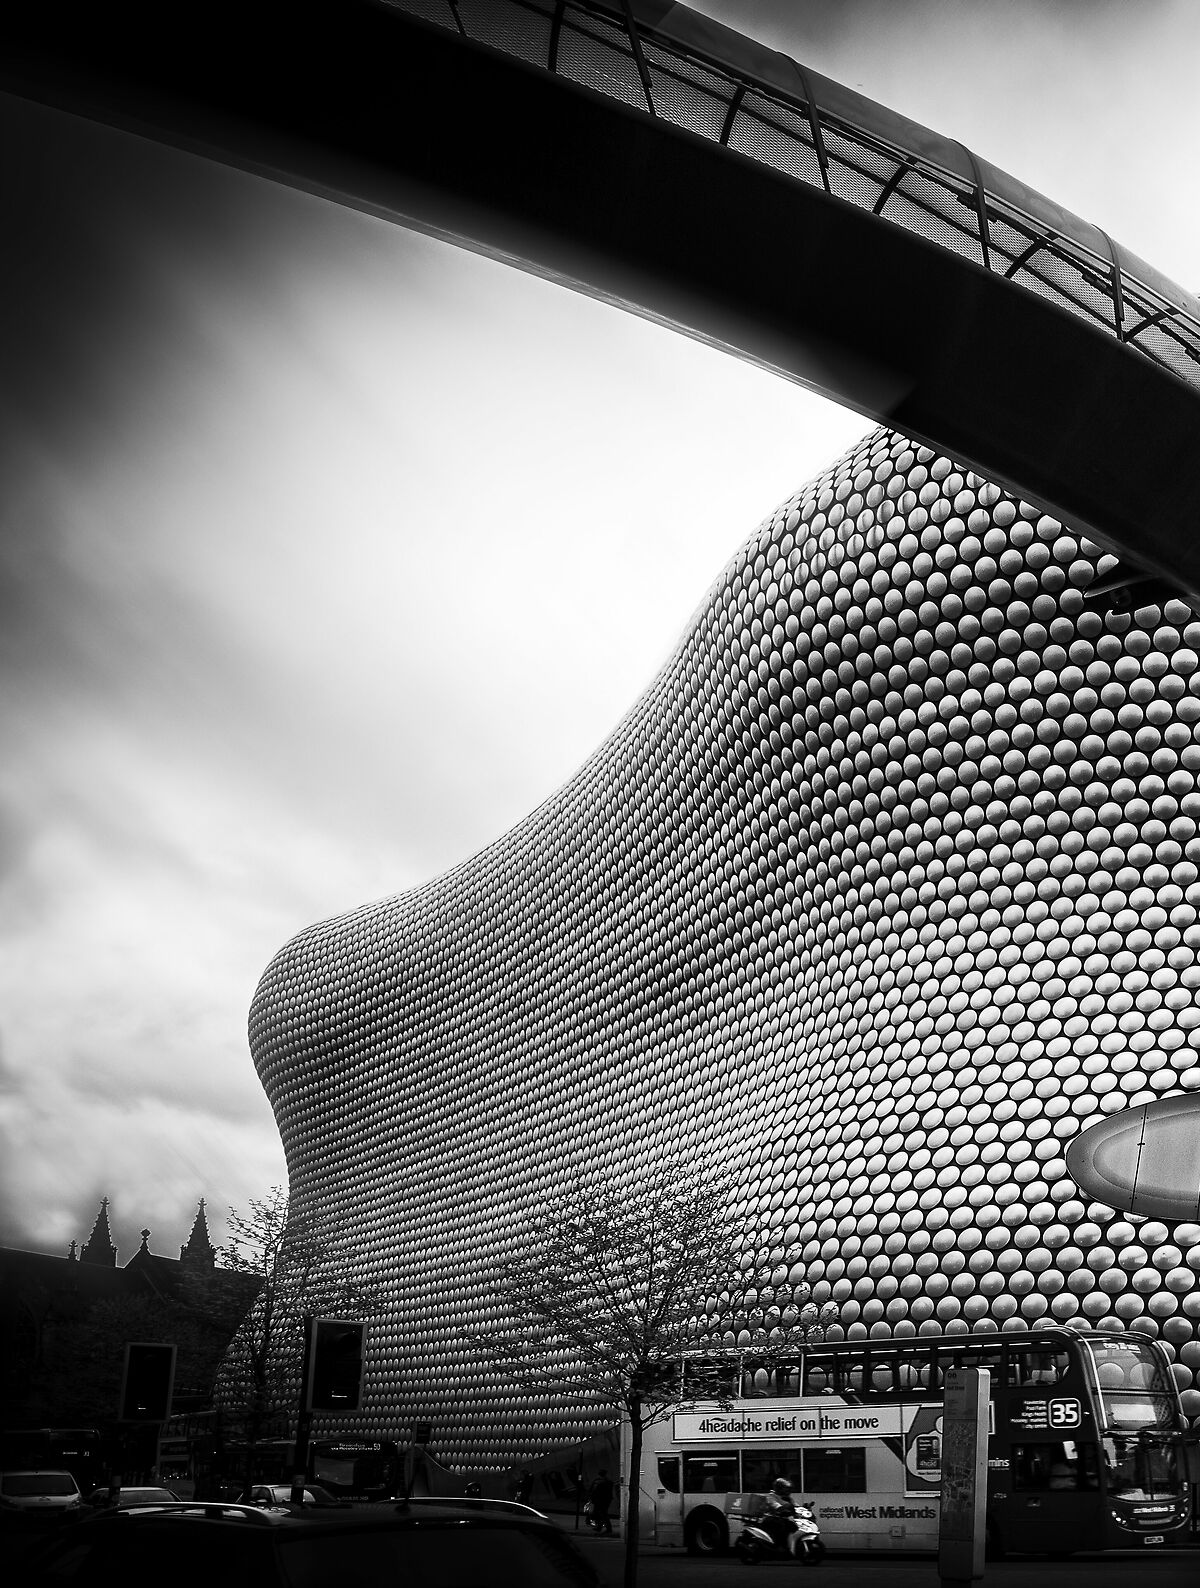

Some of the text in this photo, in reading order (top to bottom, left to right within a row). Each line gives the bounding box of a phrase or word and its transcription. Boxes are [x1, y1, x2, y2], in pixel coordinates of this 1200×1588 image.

[1052, 1404, 1078, 1423] 35
[699, 1415, 879, 1433] 4headache relief on the move
[845, 1506, 877, 1519] West
[879, 1505, 937, 1519] Midlands
